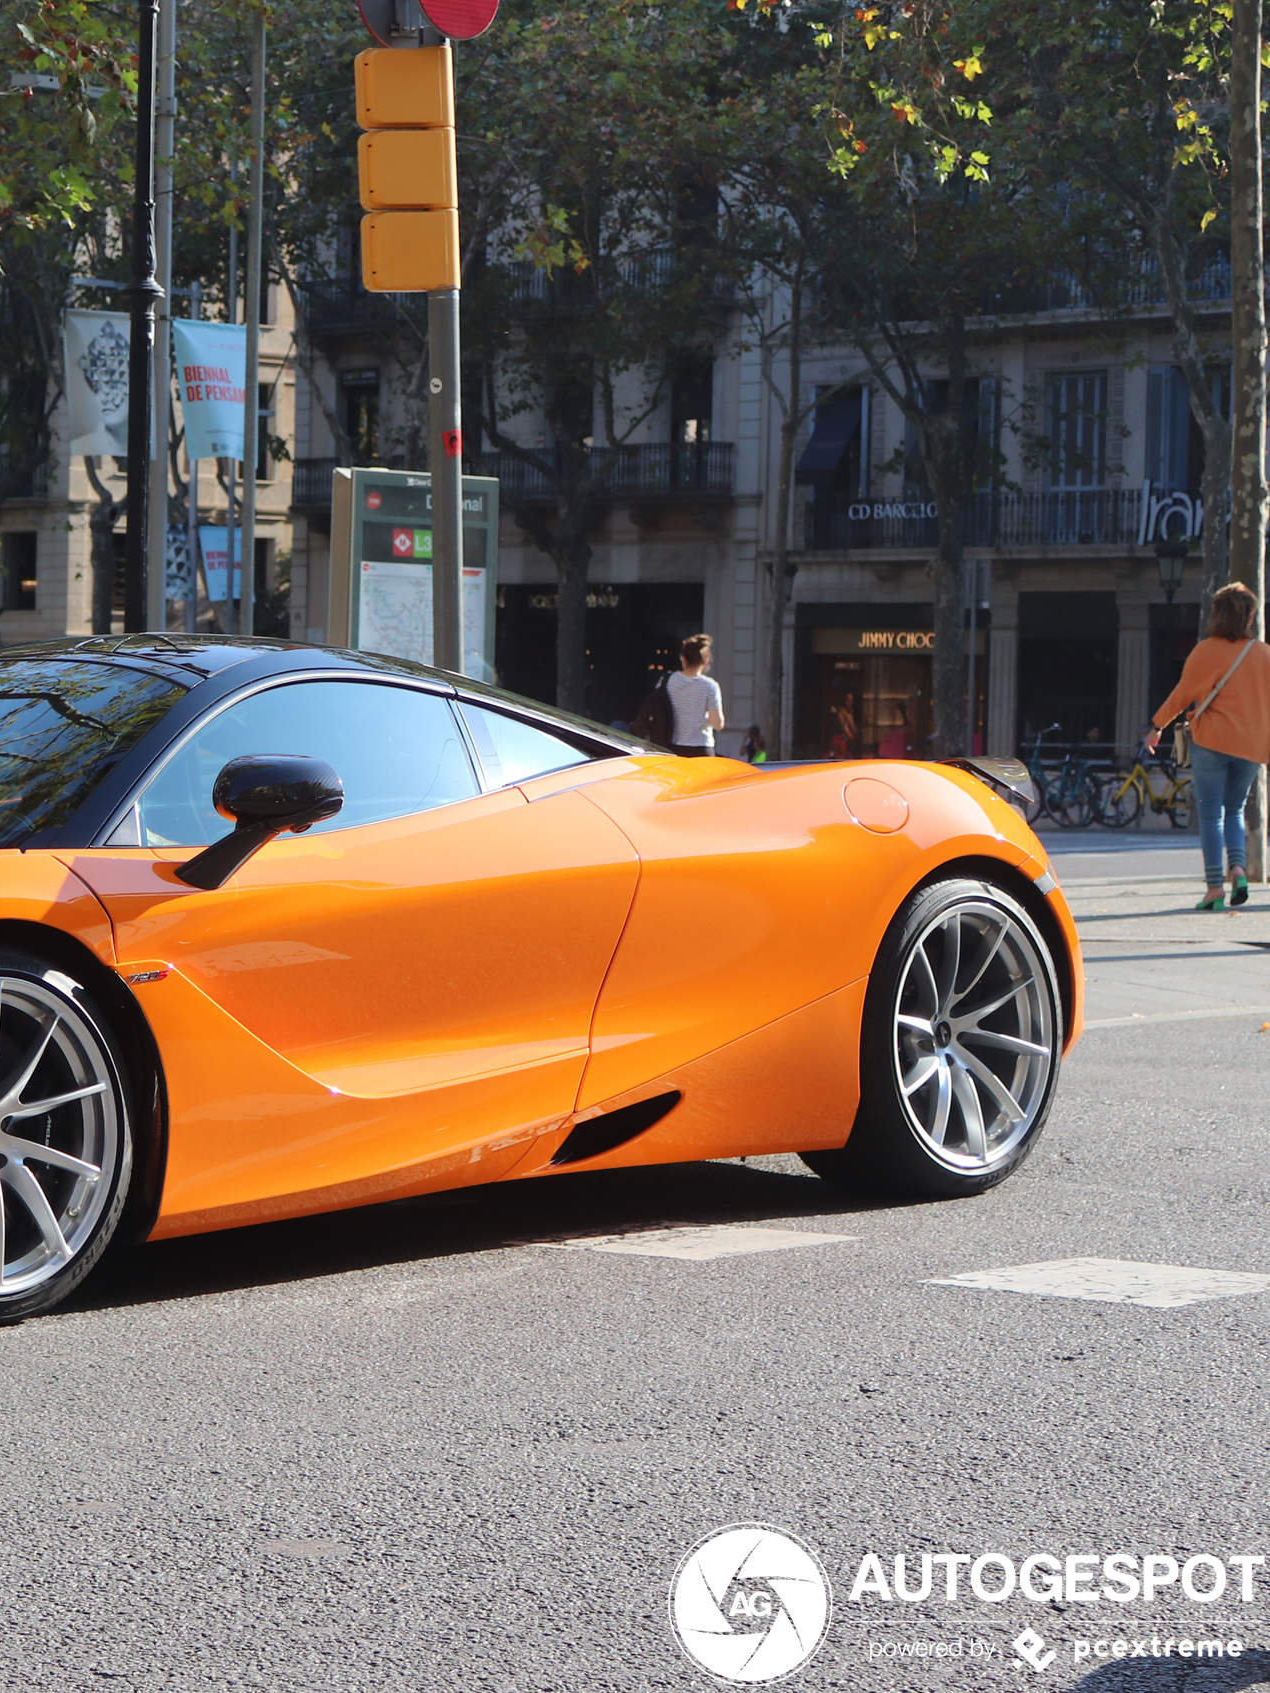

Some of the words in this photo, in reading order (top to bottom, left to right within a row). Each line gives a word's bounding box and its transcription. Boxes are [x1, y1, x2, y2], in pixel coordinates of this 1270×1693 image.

[184, 366, 231, 383] BIENNAL
[186, 385, 202, 402] DE
[848, 503, 870, 520] CD
[415, 535, 432, 552] L3
[858, 632, 895, 649] JIMMY
